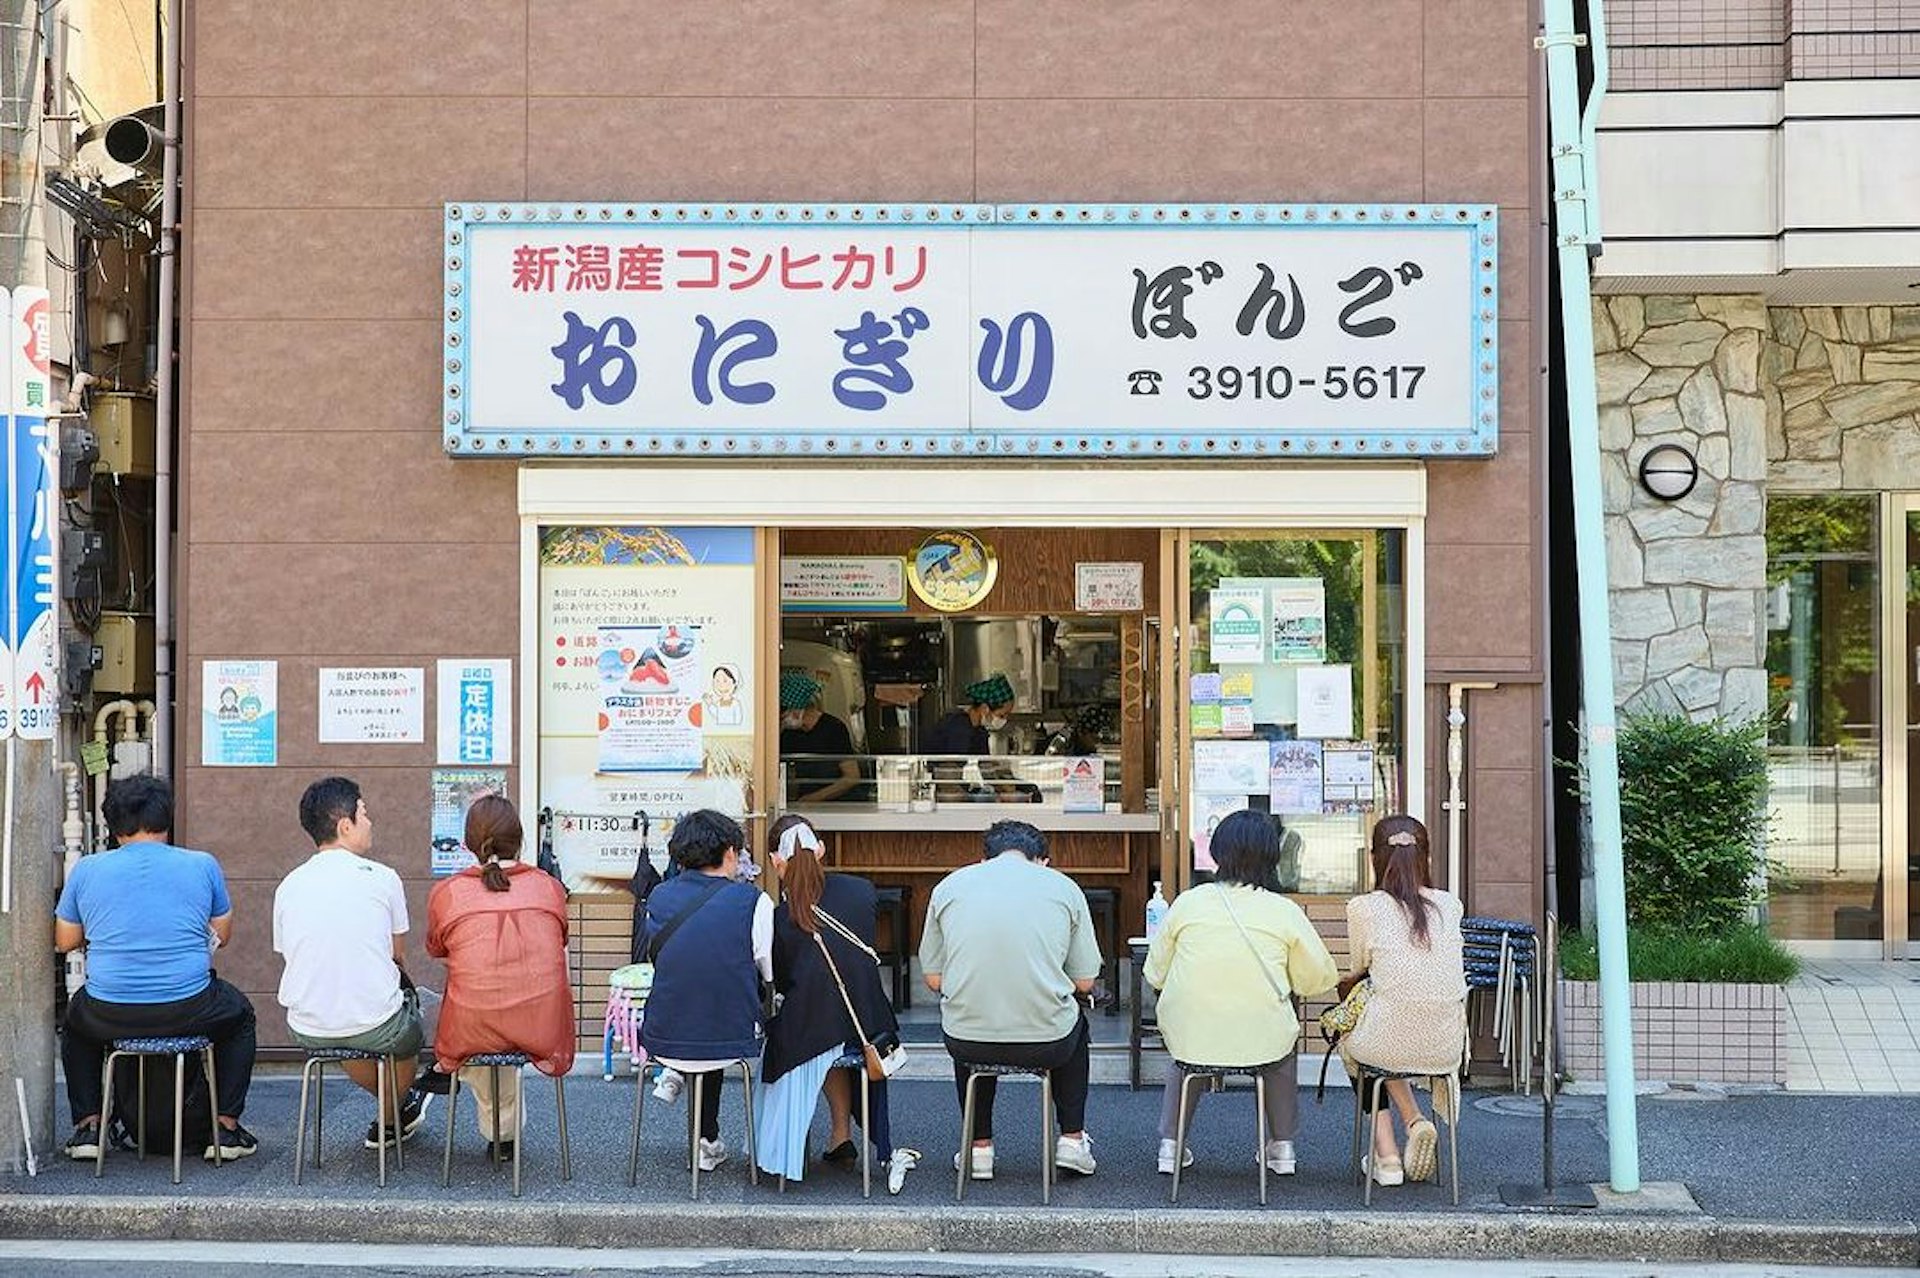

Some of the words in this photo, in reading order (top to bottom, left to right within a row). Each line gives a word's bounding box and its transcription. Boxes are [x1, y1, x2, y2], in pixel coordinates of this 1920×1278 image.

[512, 244, 927, 293] 新潟産コシヒカリ
[1131, 260, 1424, 341] ぼんご
[550, 306, 1055, 412] おにぎり
[1187, 364, 1426, 400] 3910-5617
[464, 684, 488, 759] 定休日
[578, 817, 620, 832] 11:30
